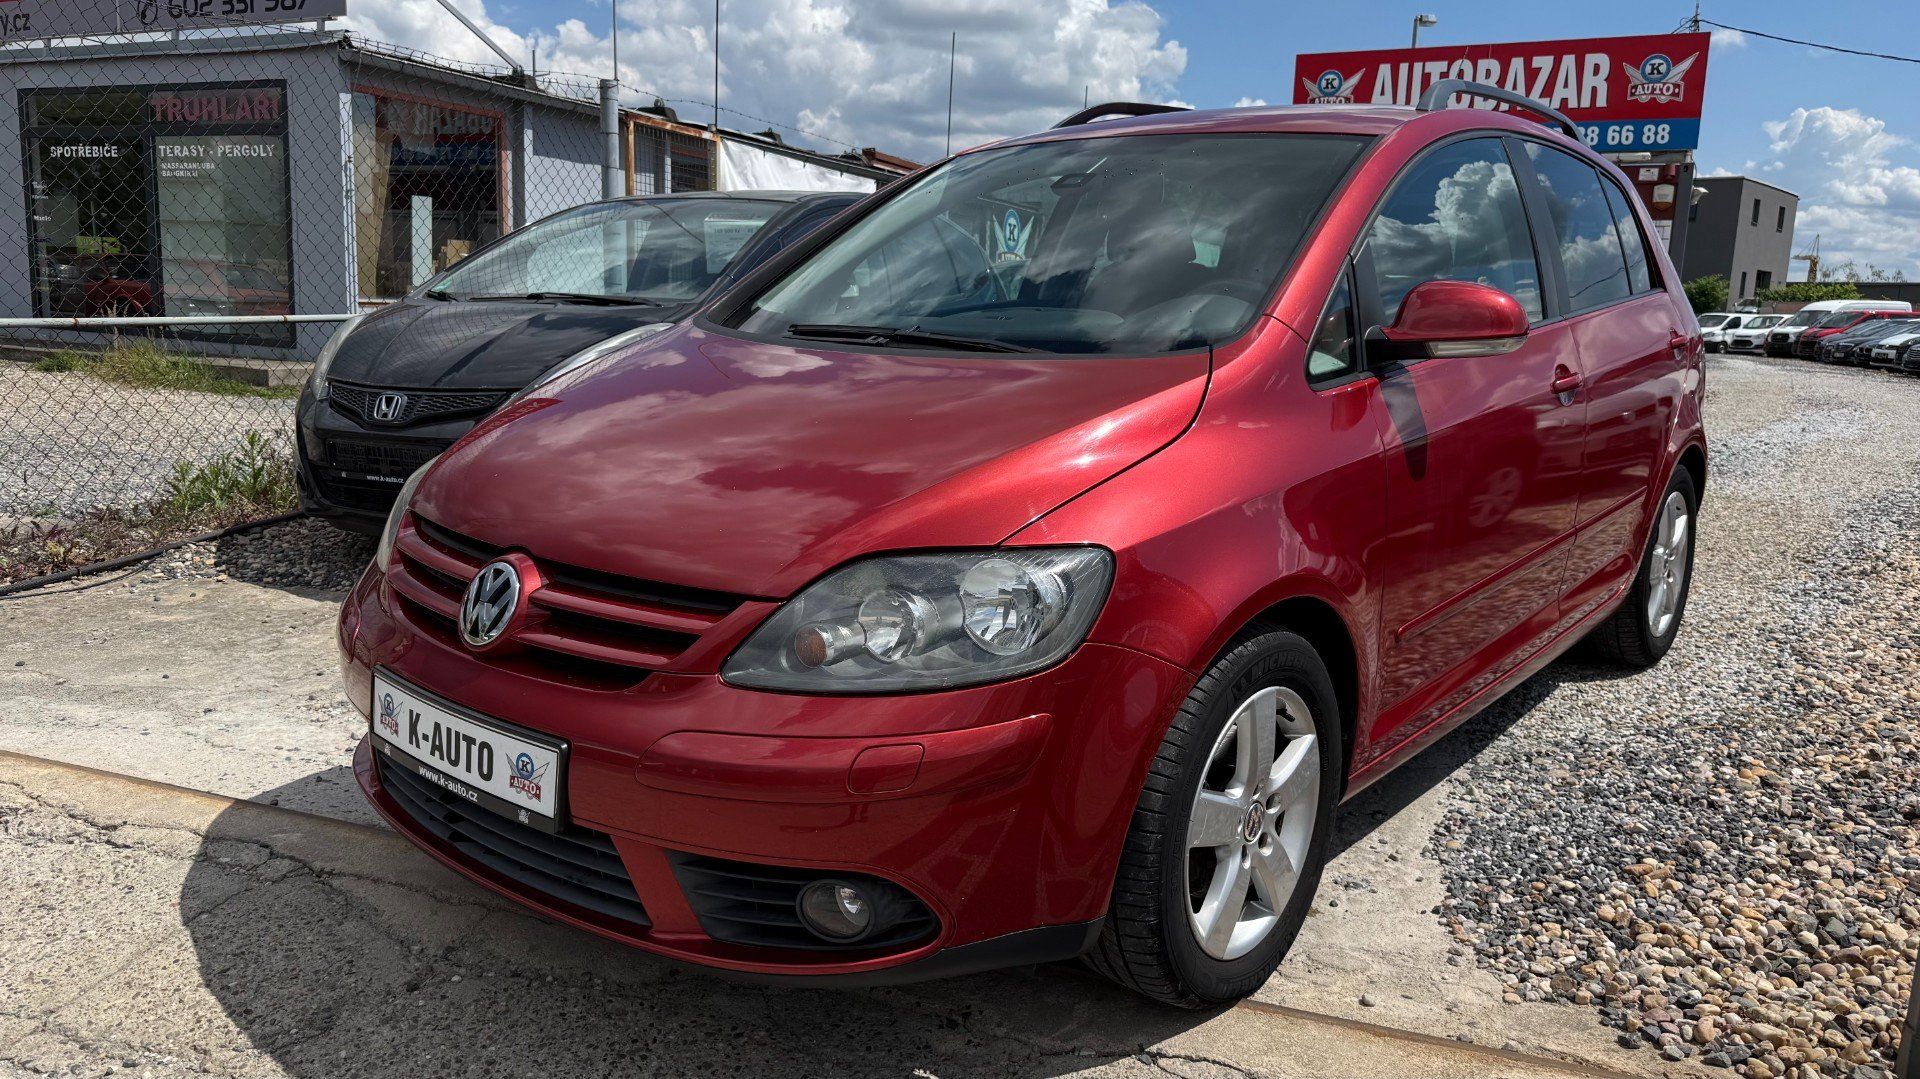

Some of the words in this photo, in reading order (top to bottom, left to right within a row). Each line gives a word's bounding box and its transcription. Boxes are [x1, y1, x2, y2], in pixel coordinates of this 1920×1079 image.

[1370, 53, 1611, 112] AUTOBAZAR
[1635, 83, 1674, 95] AUTO
[1606, 125, 1634, 145] 66
[1642, 124, 1671, 144] 88
[50, 143, 118, 158] SPOTŘEBIČE
[158, 145, 205, 157] TERASY
[217, 144, 275, 157] PERGOLY
[408, 708, 494, 782] K-AUTO
[418, 765, 478, 802] www.k-auto.cz
[513, 777, 537, 795] AUTO
